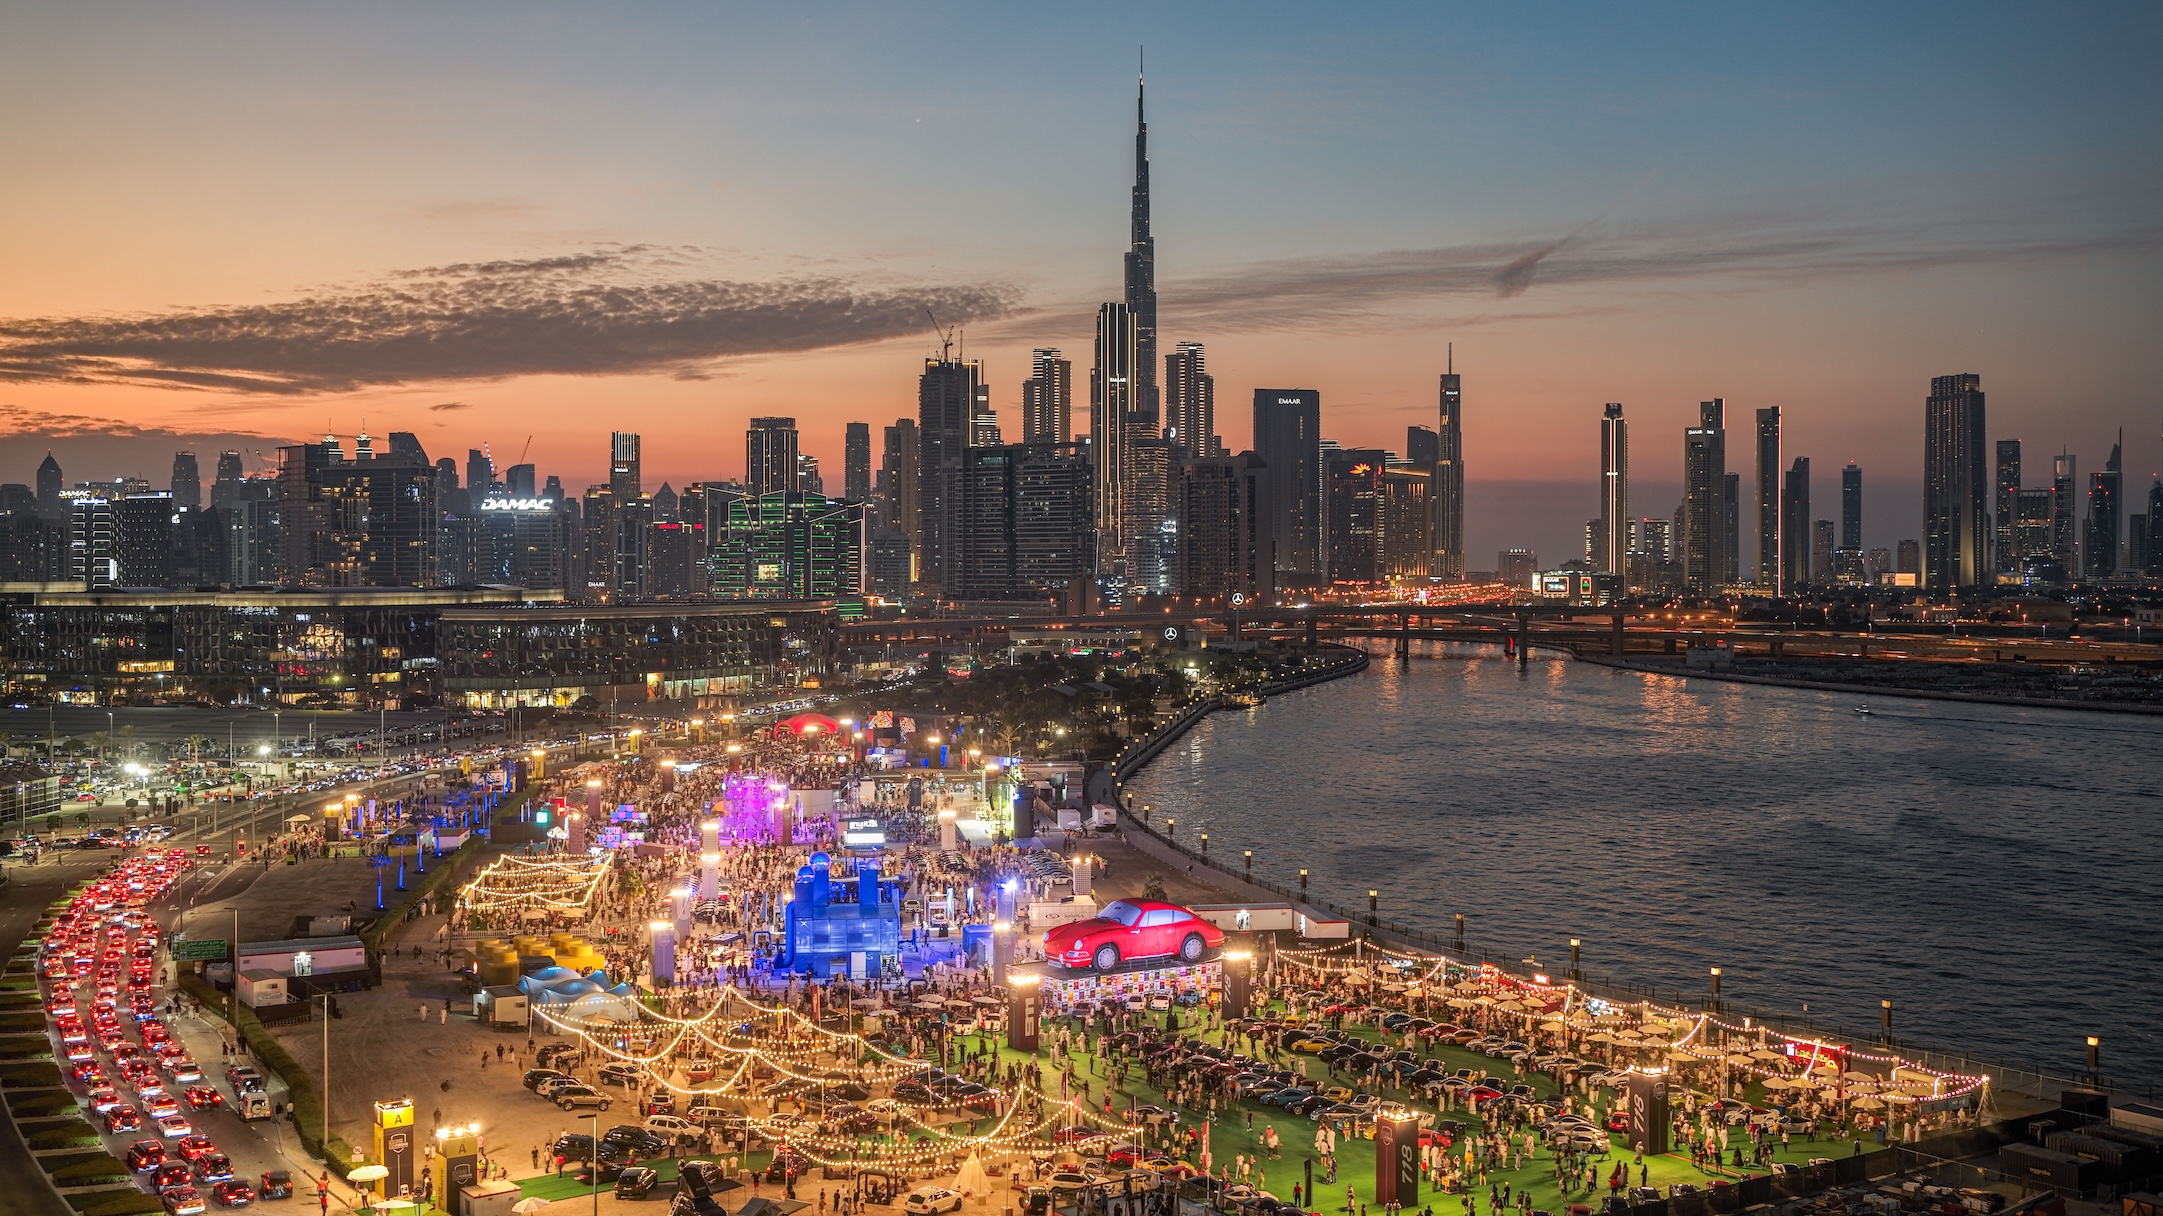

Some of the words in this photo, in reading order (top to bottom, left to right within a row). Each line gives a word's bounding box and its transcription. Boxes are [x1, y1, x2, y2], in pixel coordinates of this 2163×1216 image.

[481, 499, 553, 510] DAMAC
[1025, 997, 1034, 1036] 911
[395, 1114, 402, 1124] A
[1634, 1094, 1644, 1133] 718
[458, 1144, 466, 1154] A
[1401, 1144, 1413, 1184] 718
